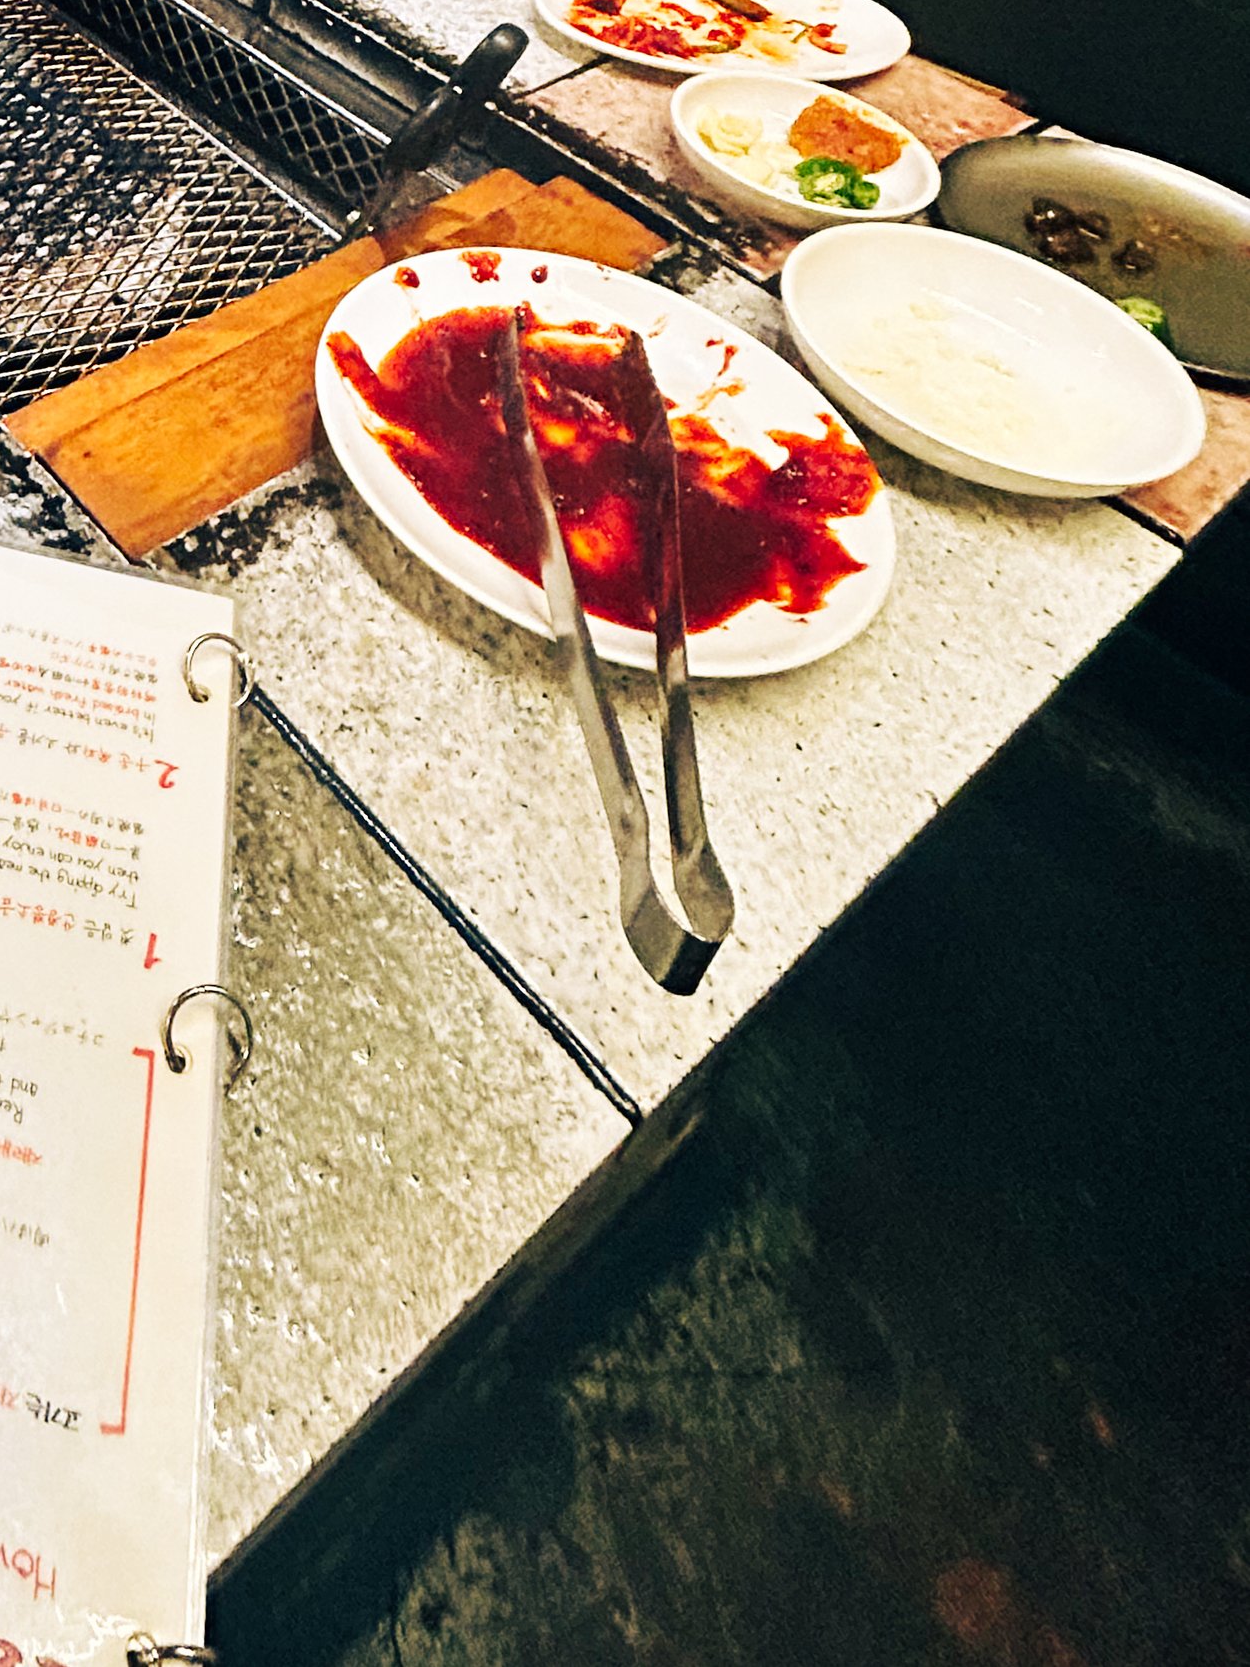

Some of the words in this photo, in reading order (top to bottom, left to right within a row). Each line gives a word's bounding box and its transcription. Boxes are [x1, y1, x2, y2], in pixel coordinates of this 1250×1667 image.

[24, 700, 38, 714] if
[44, 705, 91, 725] better
[93, 717, 128, 731] even
[131, 724, 155, 744] It's
[153, 758, 179, 789] 2
[1, 834, 45, 857] enjoy
[48, 850, 73, 864] can
[76, 856, 104, 870] you
[27, 864, 51, 883] the
[107, 865, 139, 884] then
[107, 881, 137, 910] Try
[142, 931, 162, 970] 1
[9, 1076, 39, 1097] and
[25, 1392, 79, 1432] 고기는
